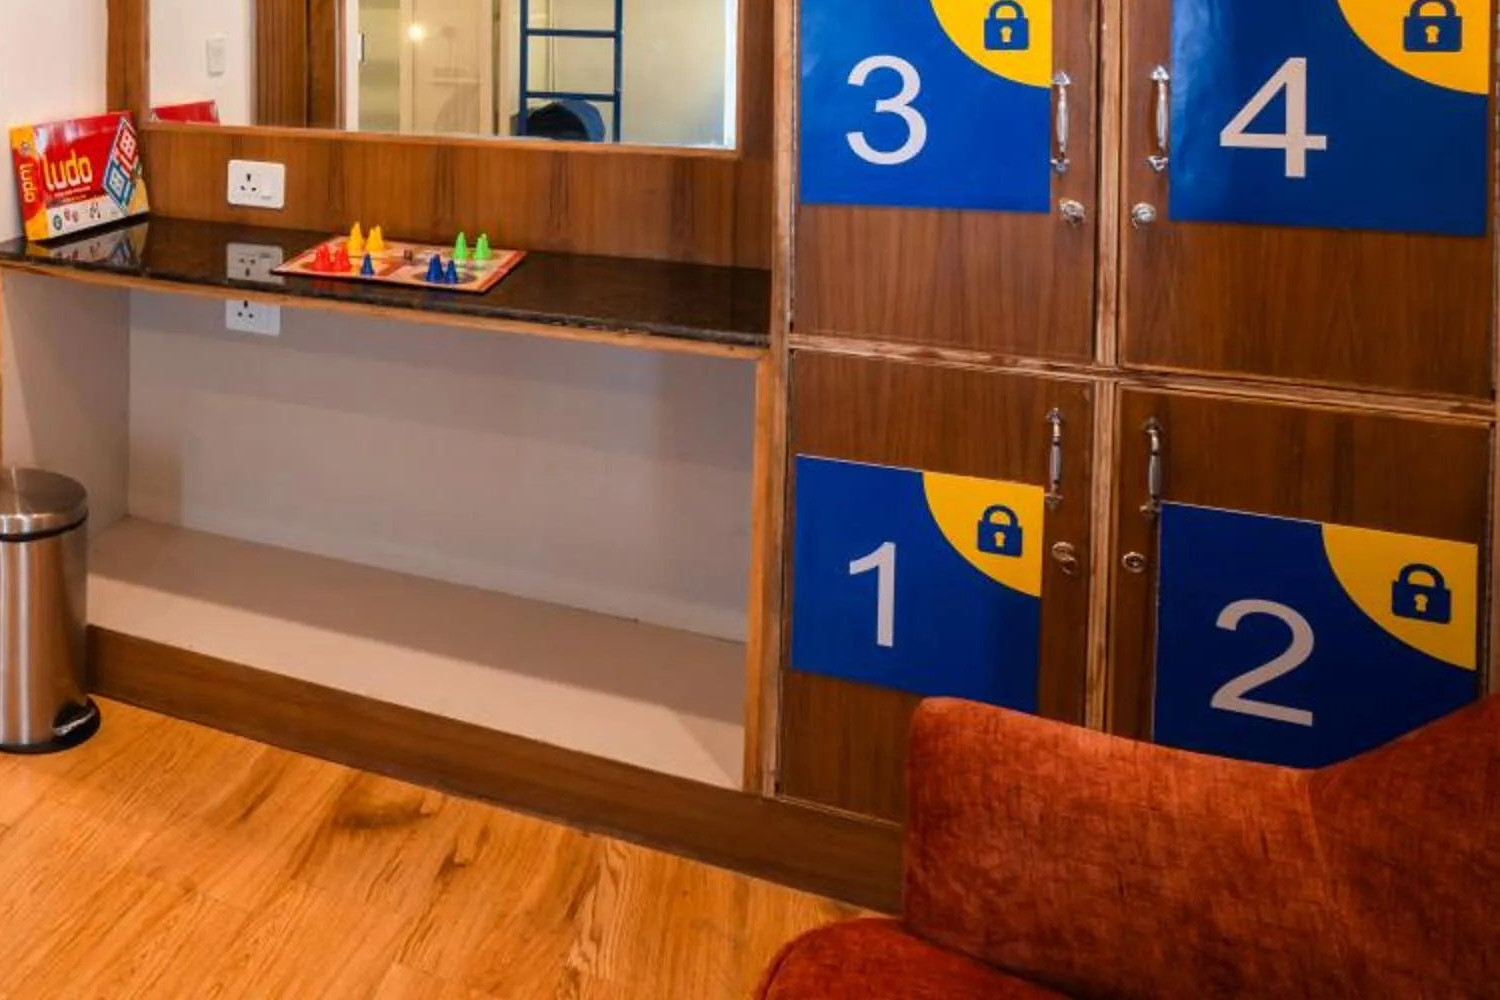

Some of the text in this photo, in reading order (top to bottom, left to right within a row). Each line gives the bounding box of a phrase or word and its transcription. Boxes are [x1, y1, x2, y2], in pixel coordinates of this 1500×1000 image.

[845, 54, 928, 166] 3
[1219, 56, 1327, 178] 4
[40, 148, 93, 191] ludo
[848, 541, 897, 648] 1
[1210, 598, 1315, 728] 2
